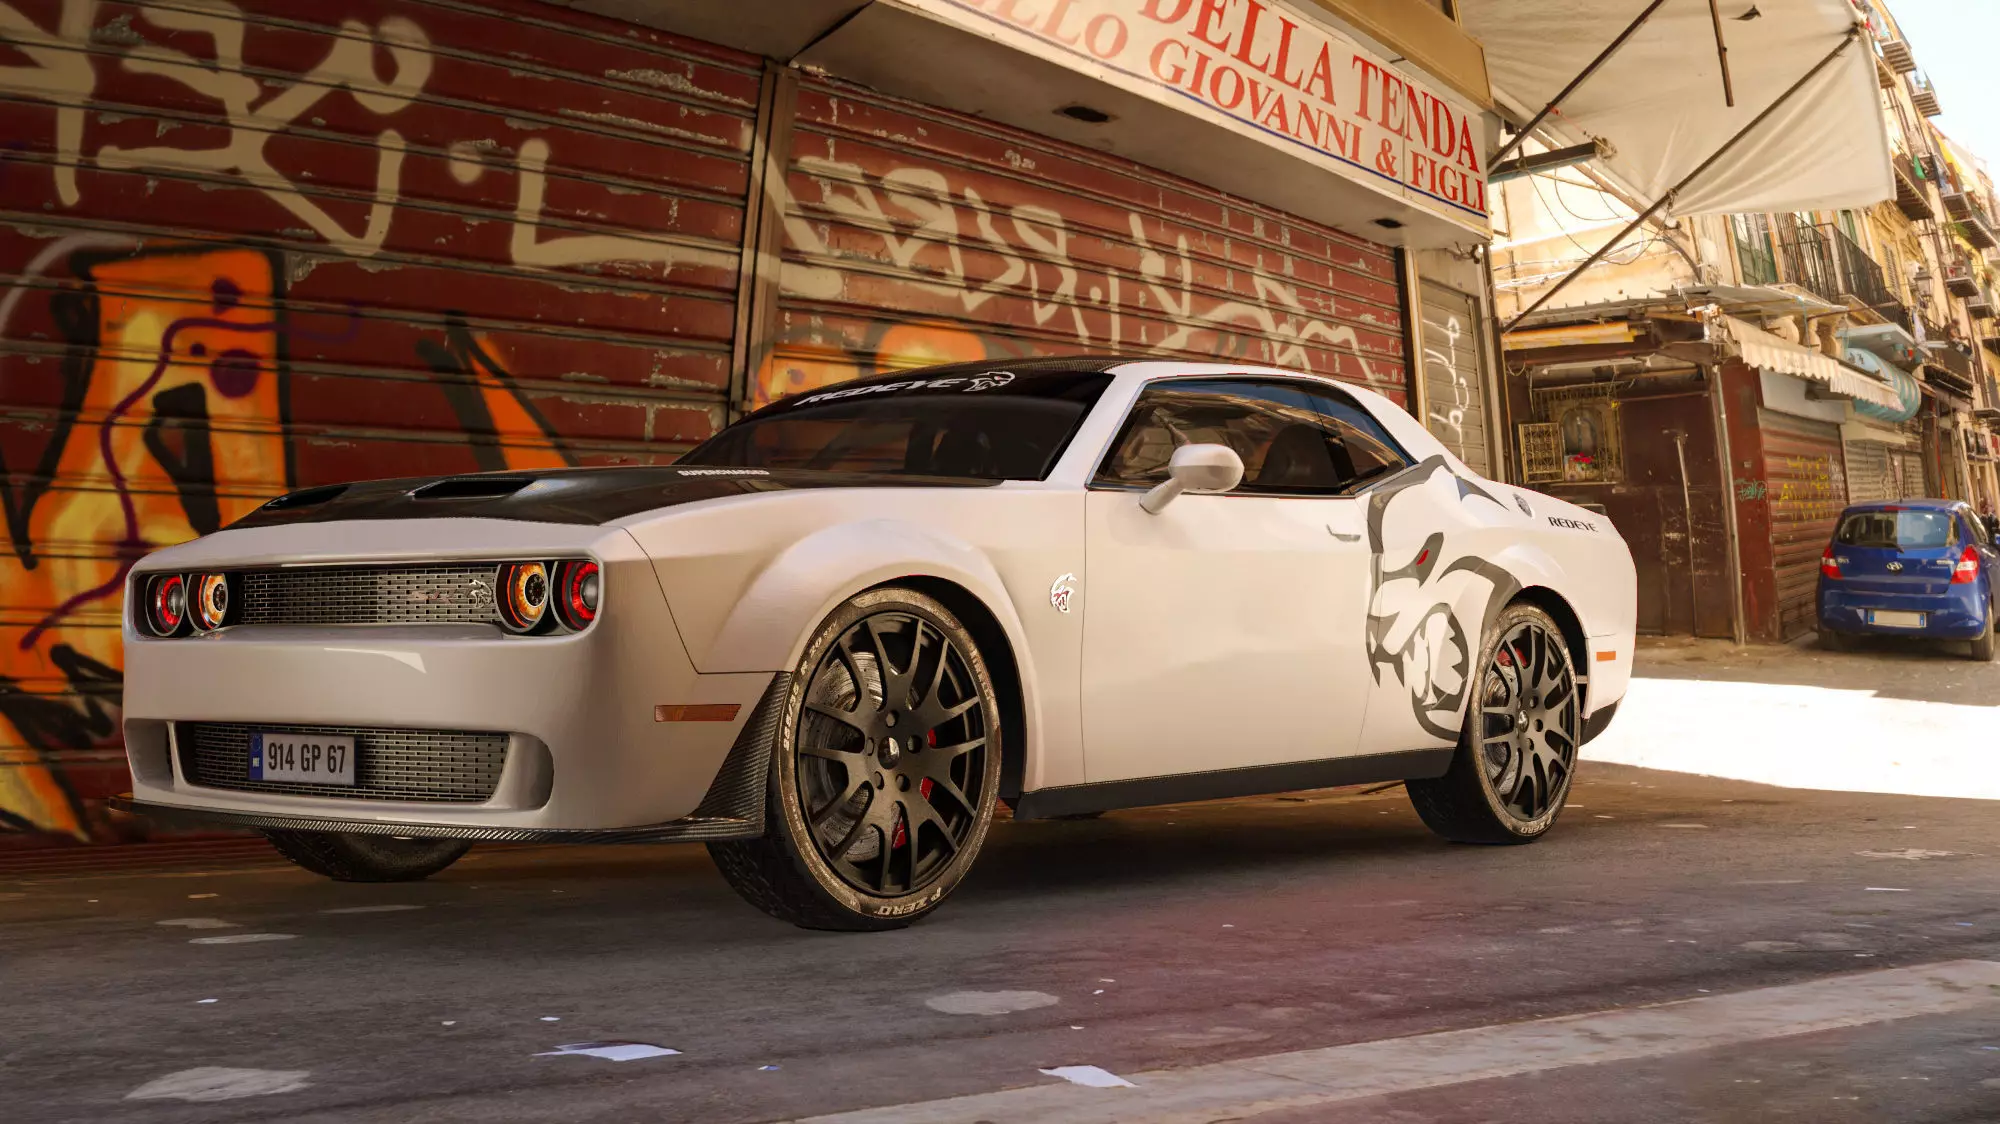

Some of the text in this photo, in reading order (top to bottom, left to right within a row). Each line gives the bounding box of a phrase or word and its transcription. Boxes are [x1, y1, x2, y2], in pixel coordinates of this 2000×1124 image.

[1150, 38, 1364, 163] GIOVANNI
[1375, 138, 1397, 177] &
[1410, 150, 1487, 213] FIGLI
[1352, 54, 1480, 174] TENDA
[793, 378, 969, 407] REDEYE
[1548, 516, 1599, 533] REDEYE
[268, 742, 346, 773] 914 GP 67
[877, 886, 942, 916] P ZERO
